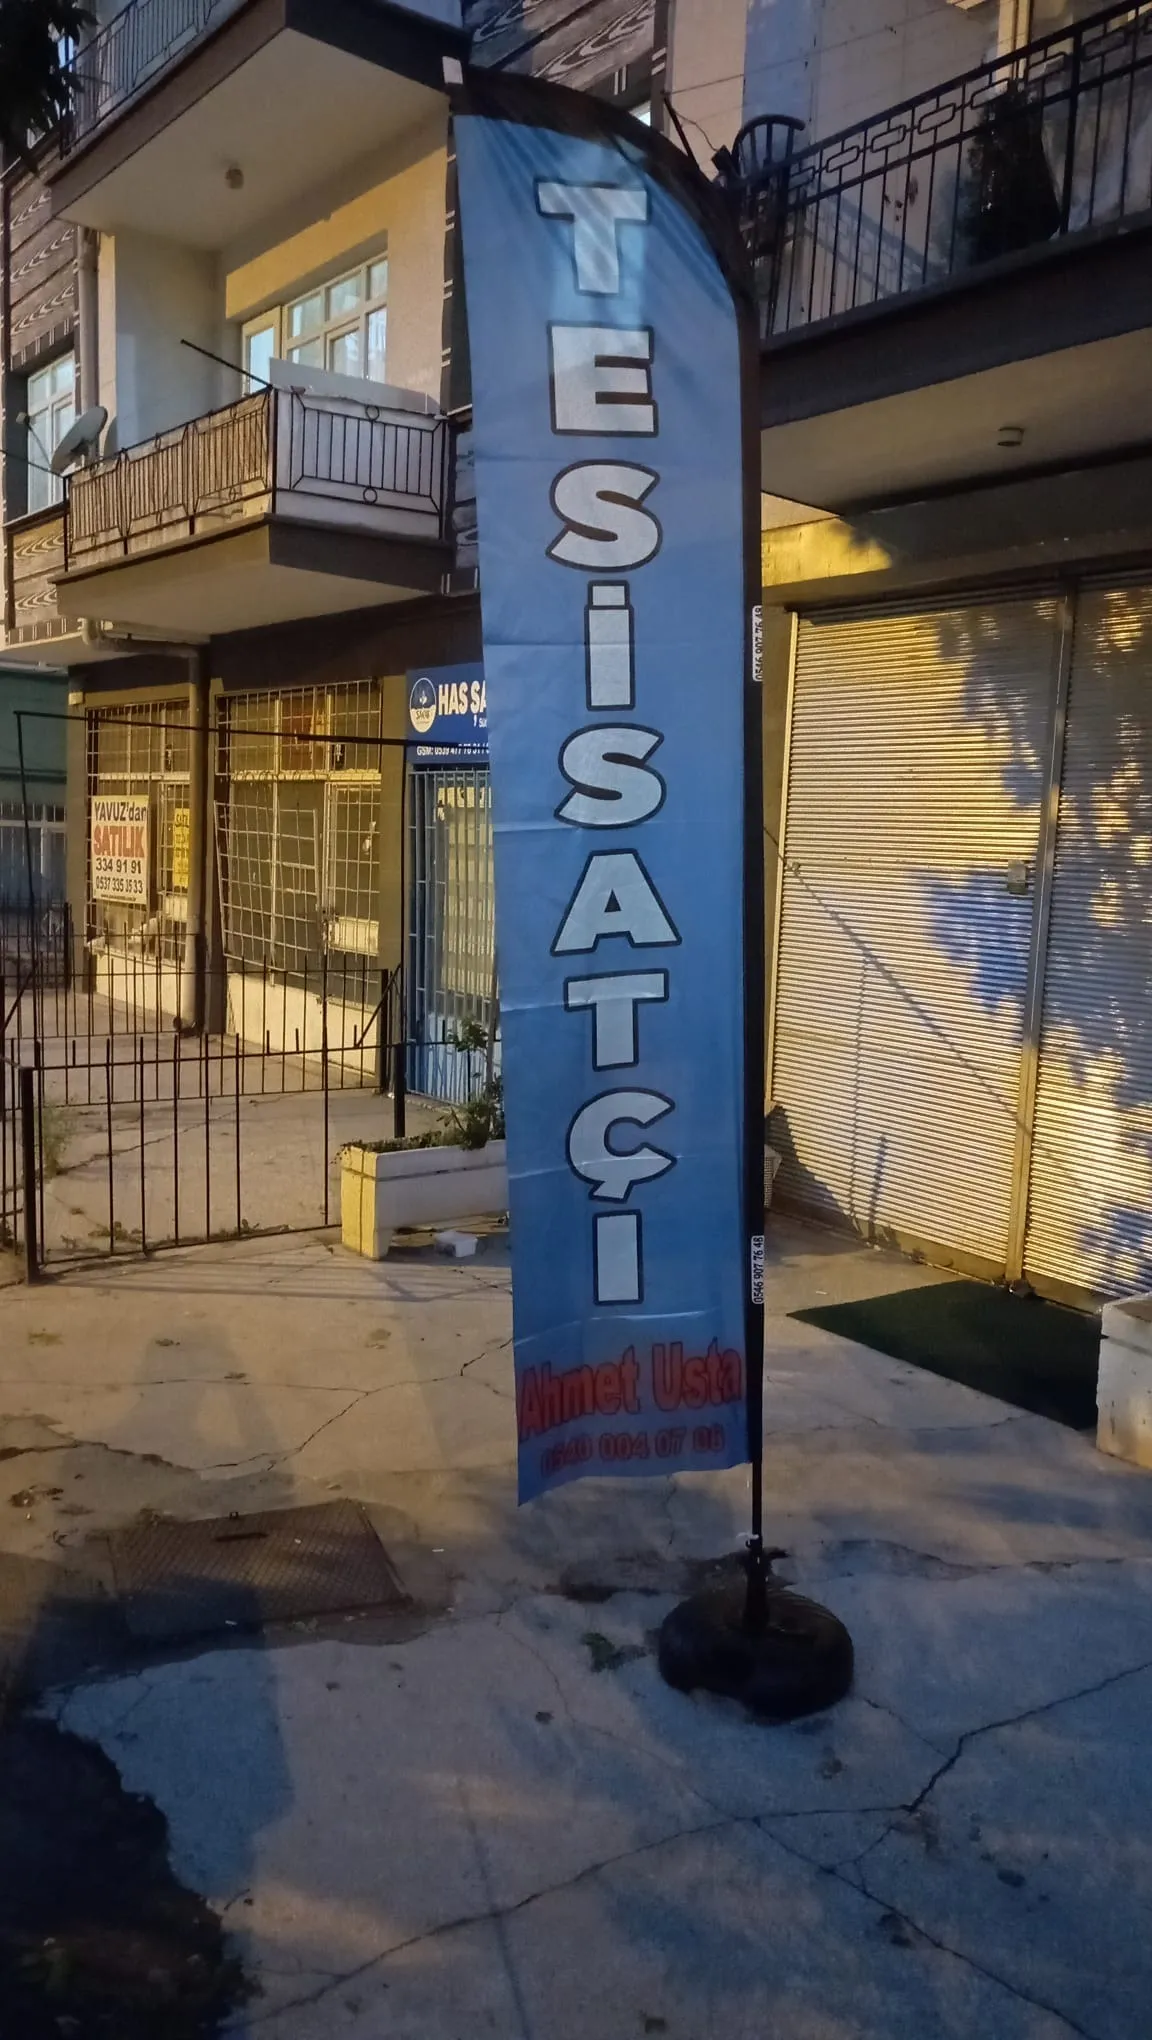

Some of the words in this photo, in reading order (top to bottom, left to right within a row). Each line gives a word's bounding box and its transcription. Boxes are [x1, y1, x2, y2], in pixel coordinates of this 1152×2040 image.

[438, 681, 468, 716] HAS
[93, 824, 145, 858] SATILIK
[95, 857, 114, 872] 334
[116, 859, 128, 874] 91
[130, 860, 142, 875] 91
[753, 1236, 764, 1249] 48
[753, 1249, 764, 1261] 76
[753, 1264, 764, 1280] 907
[753, 1281, 764, 1303] 0546
[518, 1344, 641, 1445] Ahmet
[651, 1335, 743, 1413] Usta
